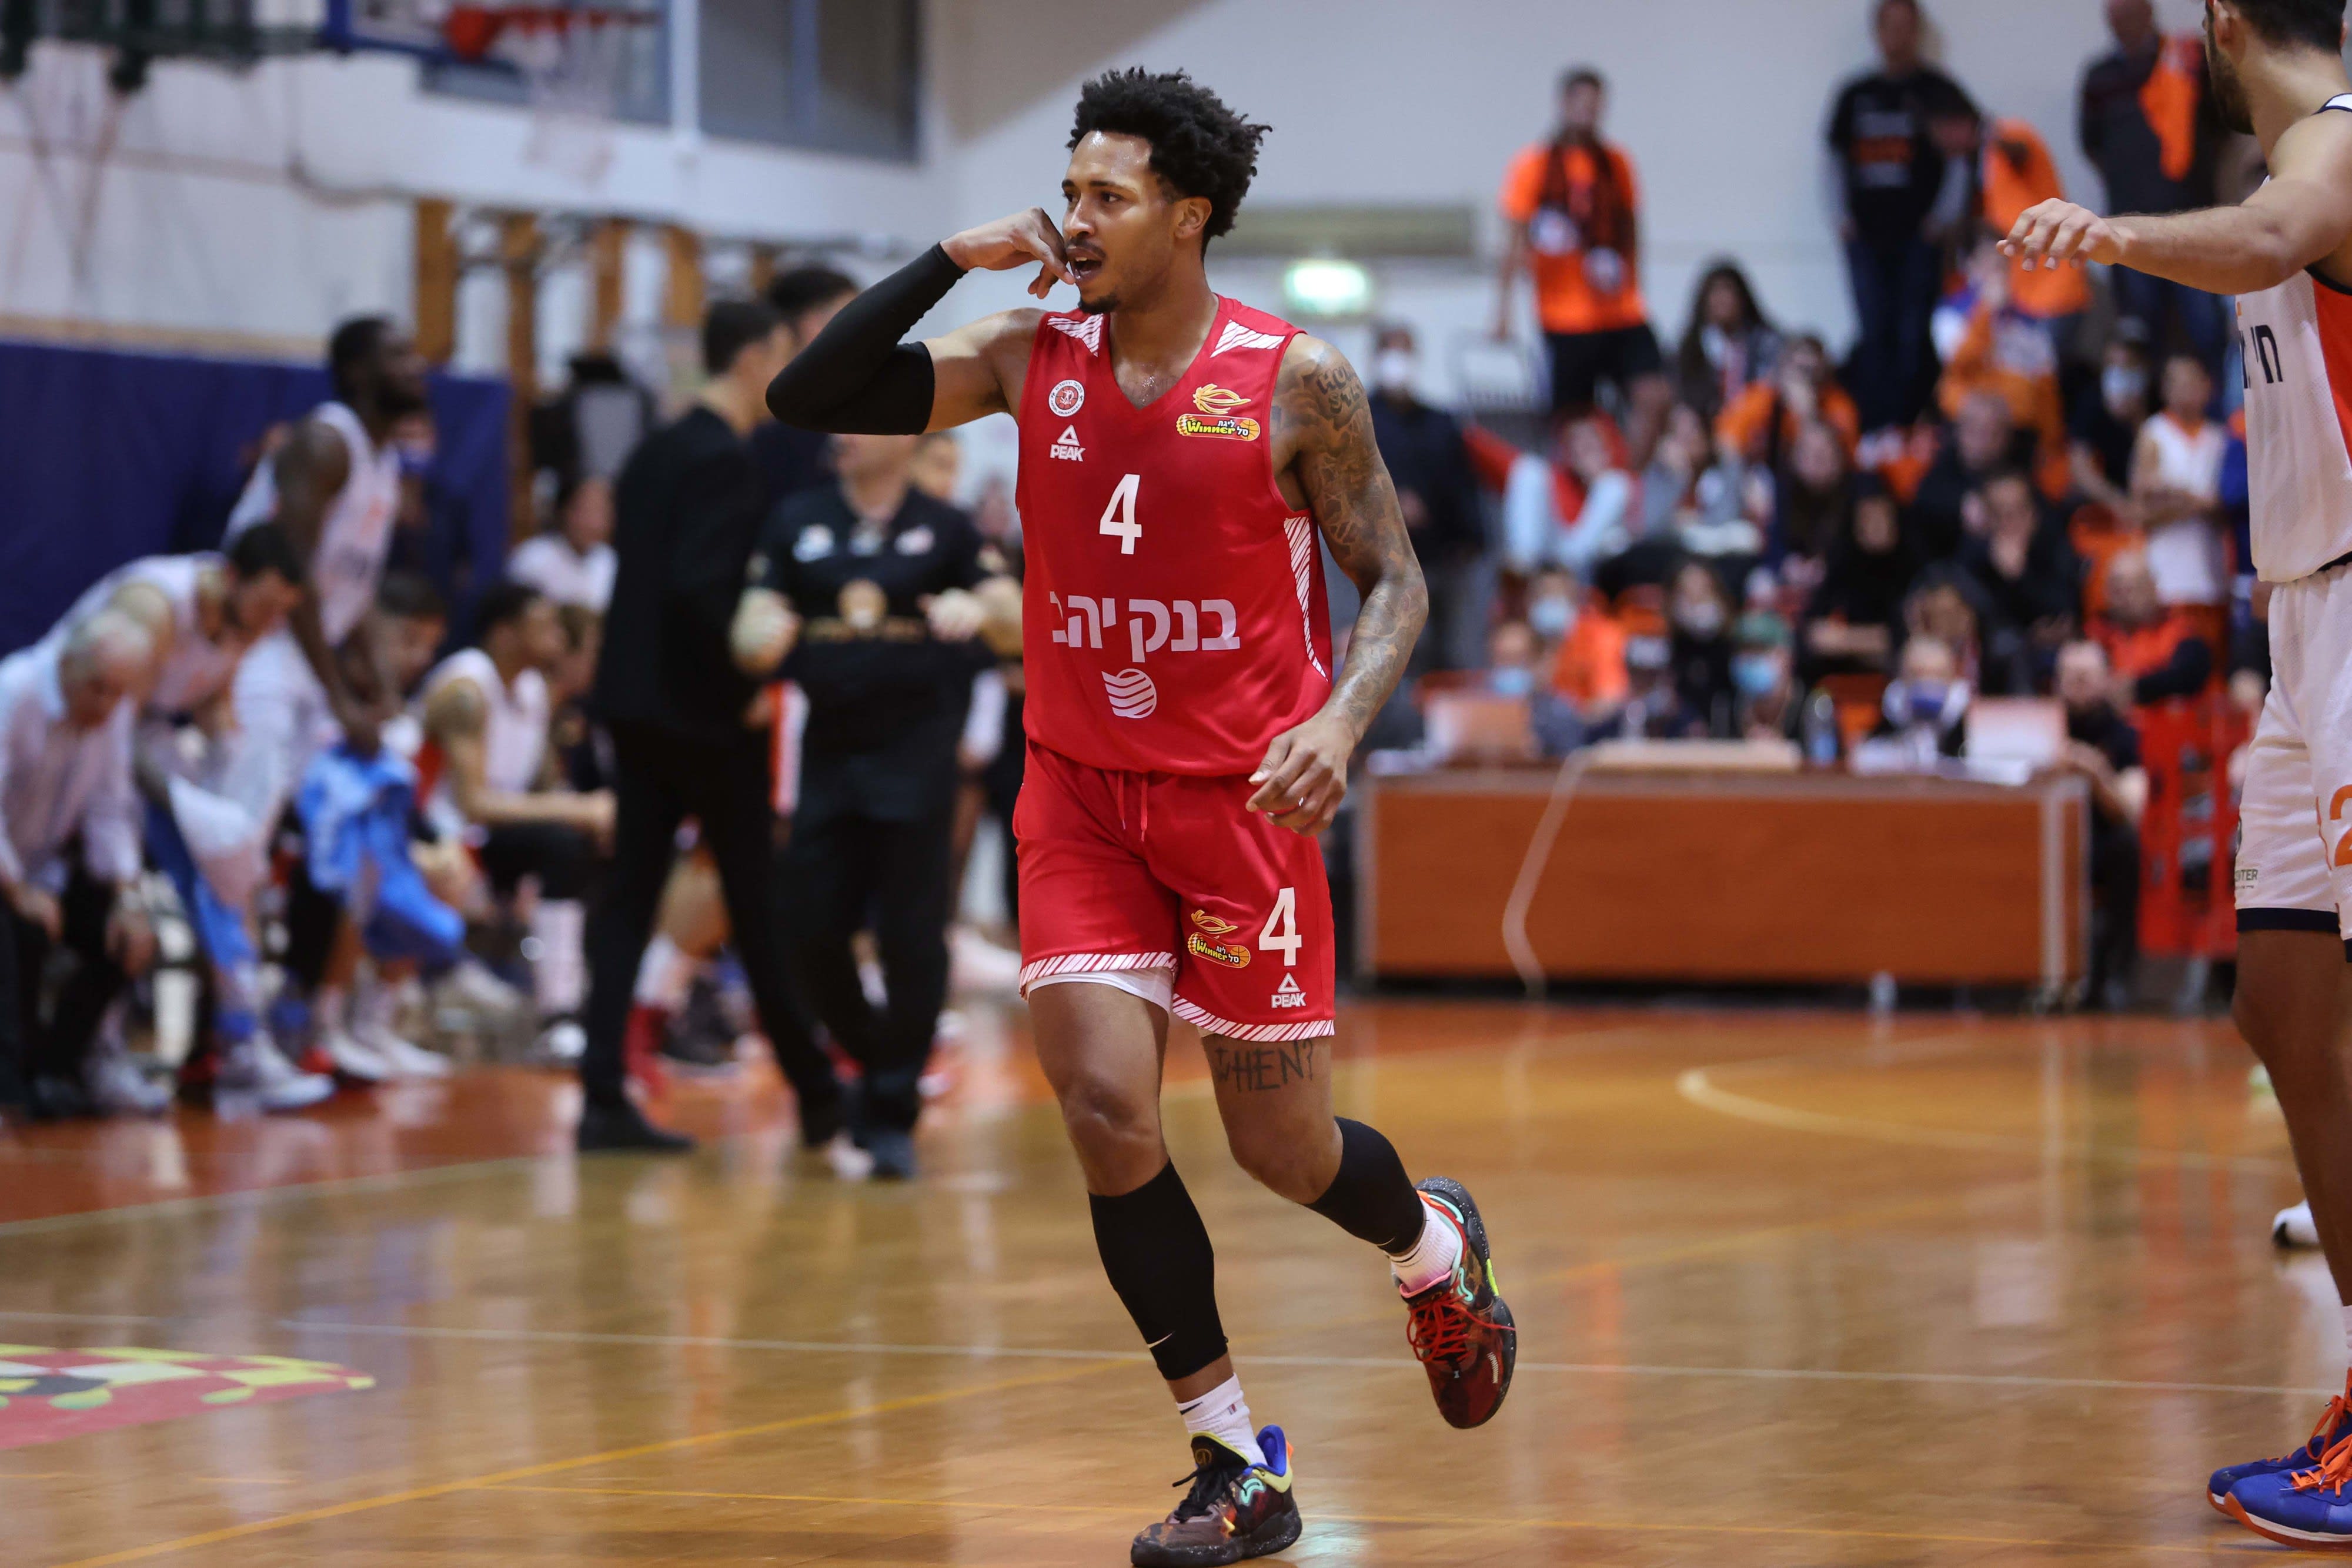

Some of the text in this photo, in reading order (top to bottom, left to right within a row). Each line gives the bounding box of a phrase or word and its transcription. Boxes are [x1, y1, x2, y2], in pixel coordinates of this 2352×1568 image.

[1187, 420, 1249, 436] Winner סל
[1217, 419, 1235, 427] ליגת
[1050, 443, 1086, 462] PEAK
[1099, 473, 1142, 555] 4
[1128, 598, 1241, 663] בנק
[1258, 887, 1302, 967] 4
[1228, 953, 1240, 964] סל
[1271, 992, 1307, 1008] PEAK
